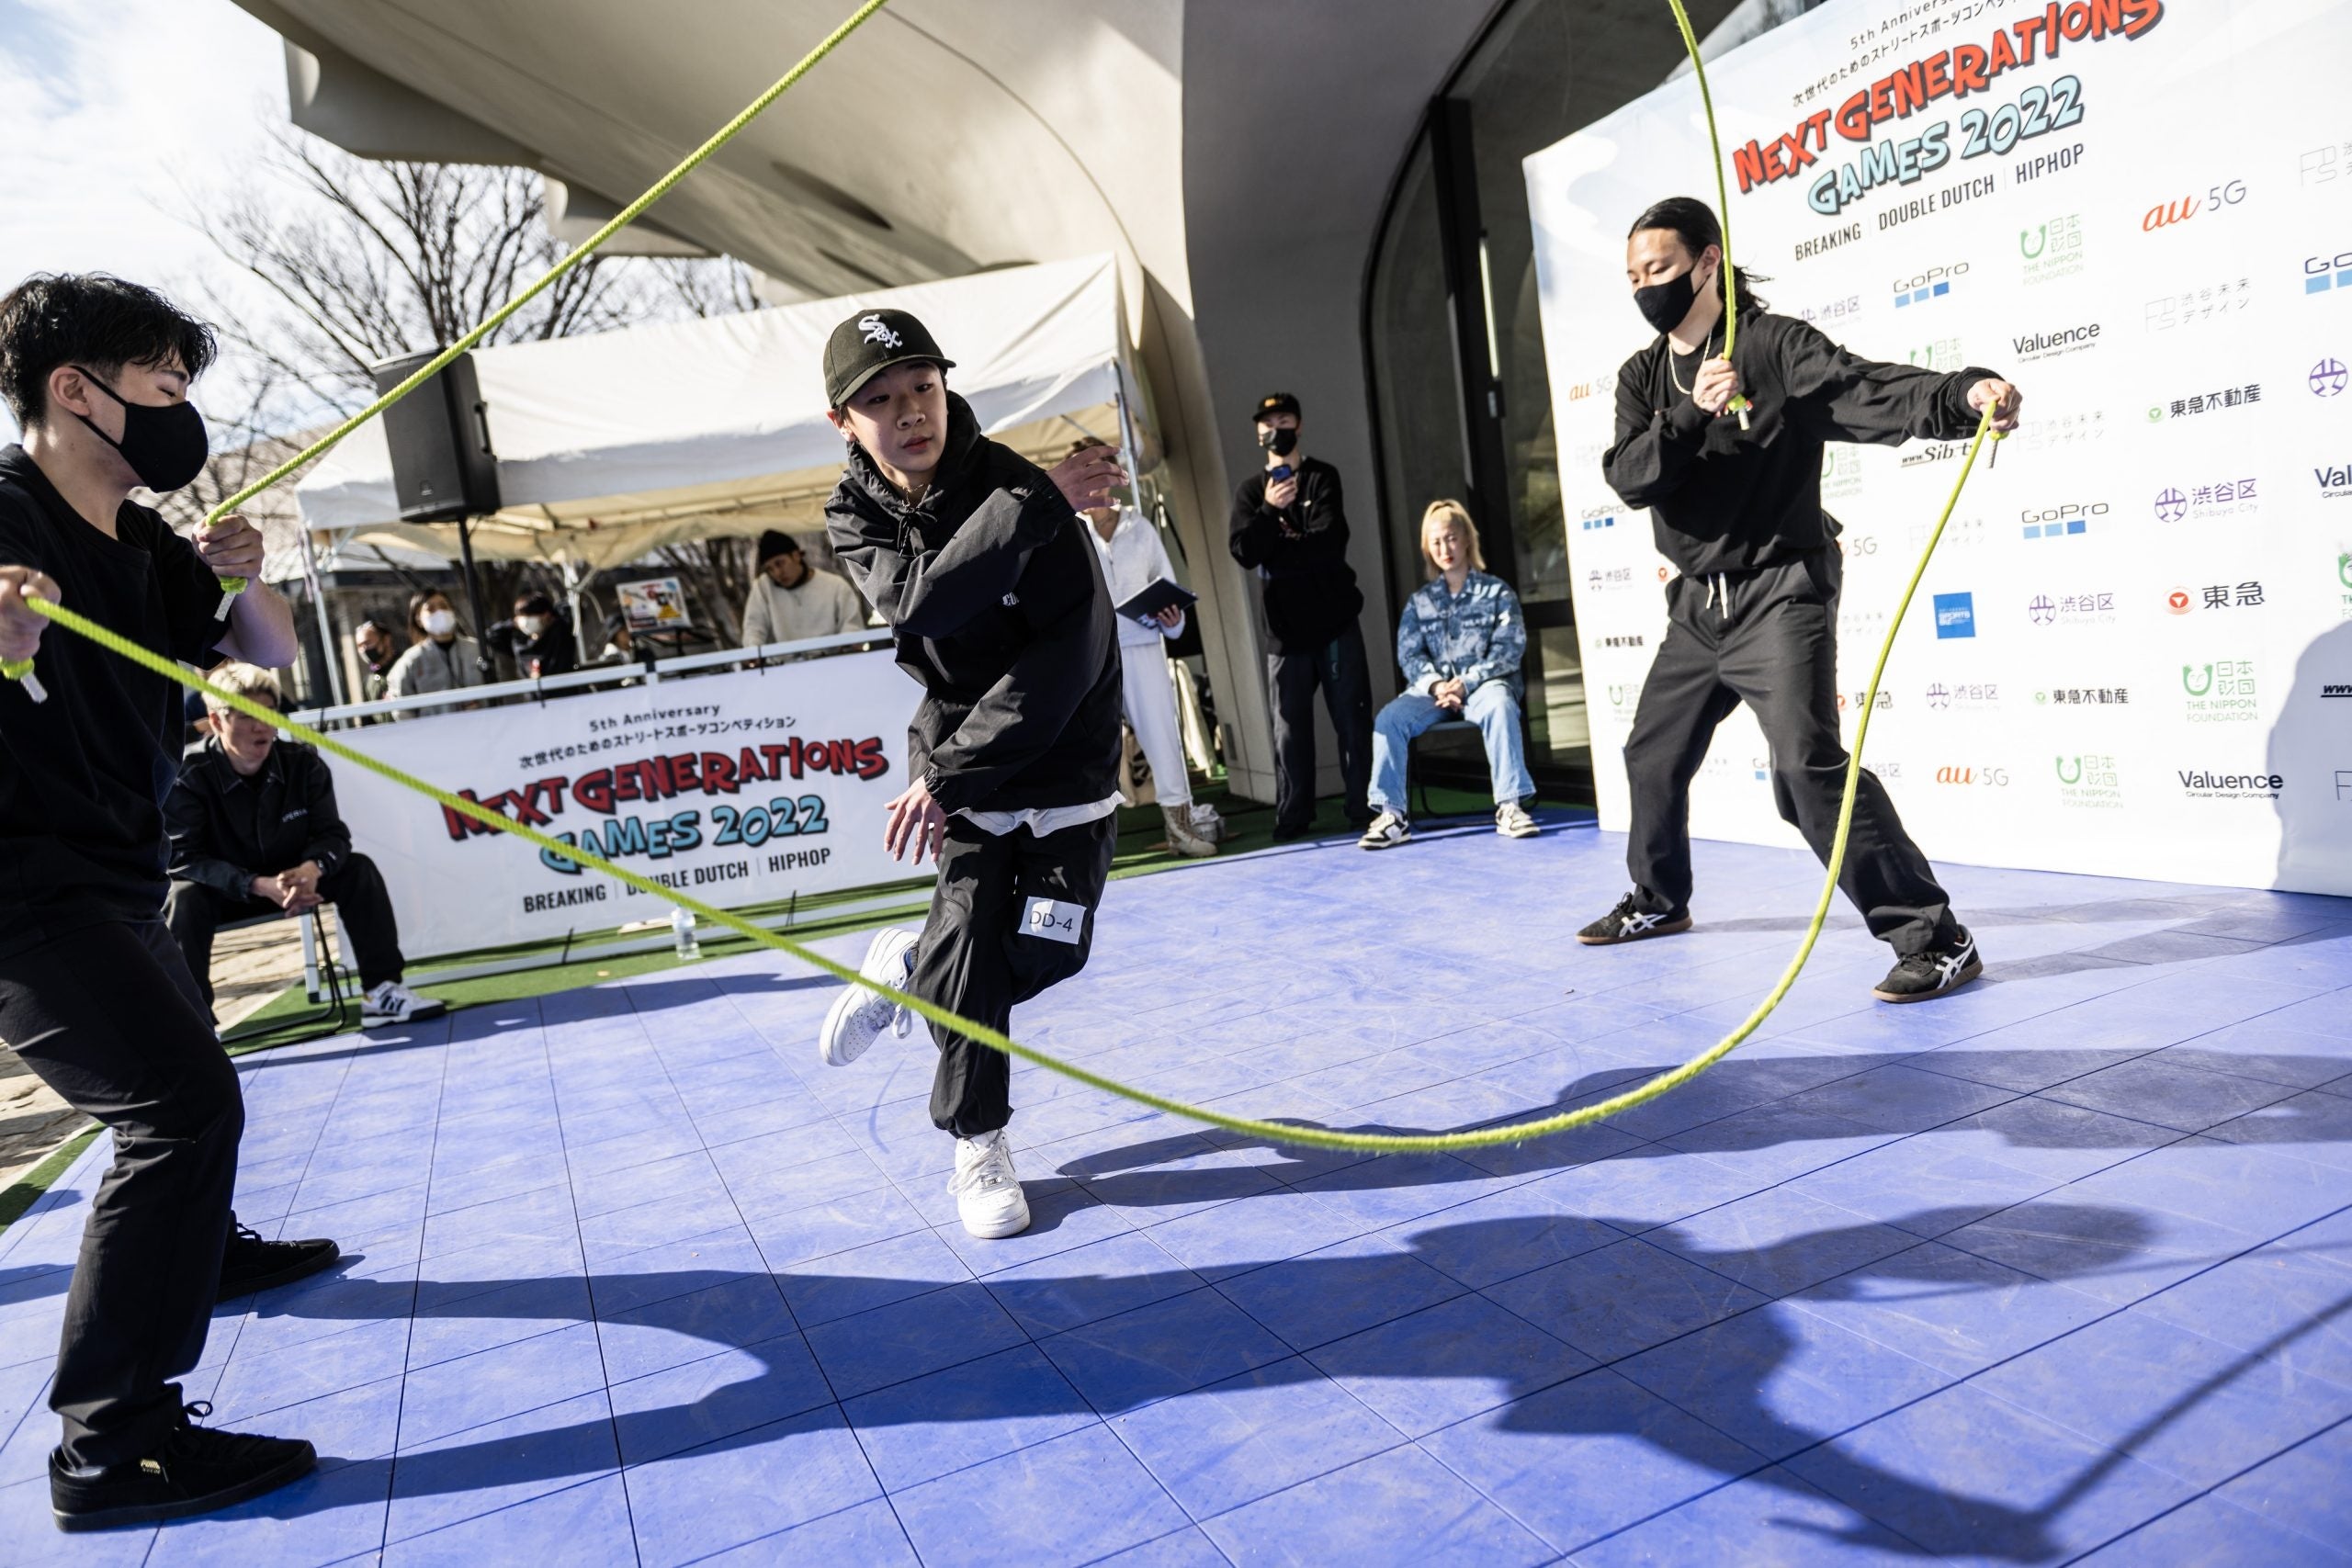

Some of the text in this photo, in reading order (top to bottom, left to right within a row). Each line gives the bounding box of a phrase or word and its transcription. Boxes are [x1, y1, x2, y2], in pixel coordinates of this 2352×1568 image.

[1850, 28, 1875, 51] 5th
[1733, 108, 1832, 194] NEXT
[1808, 74, 2084, 215] GAMES 2022
[1795, 143, 2085, 262] BREAKING DOUBLE DUTCH HIPHOP
[2143, 179, 2247, 231] au 5G
[1894, 262, 1970, 293] GoPro
[2013, 323, 2101, 355] Valuence
[2170, 383, 2262, 419] 東急不動産
[2192, 479, 2257, 506] 渋谷区
[2022, 502, 2109, 524] GoPro
[2060, 592, 2114, 613] 渋谷区
[2202, 581, 2266, 610] 東急
[2216, 660, 2254, 678] 日本
[2053, 687, 2130, 705] 東急不動産
[2187, 698, 2257, 710] THE NIPPON
[590, 704, 720, 733] 5th Anniversary
[2187, 712, 2258, 724] FOUNDATION
[571, 736, 889, 815] GENERATIONS
[1937, 766, 2009, 786] au 5G
[2178, 771, 2284, 789] Valuence
[2242, 791, 2279, 799] Company
[538, 795, 830, 875] GAMES 2022
[523, 884, 607, 914] BREAKING
[695, 861, 749, 886] DUTCH
[768, 847, 831, 873] HIPHOP
[1029, 910, 1073, 932] DD-4
